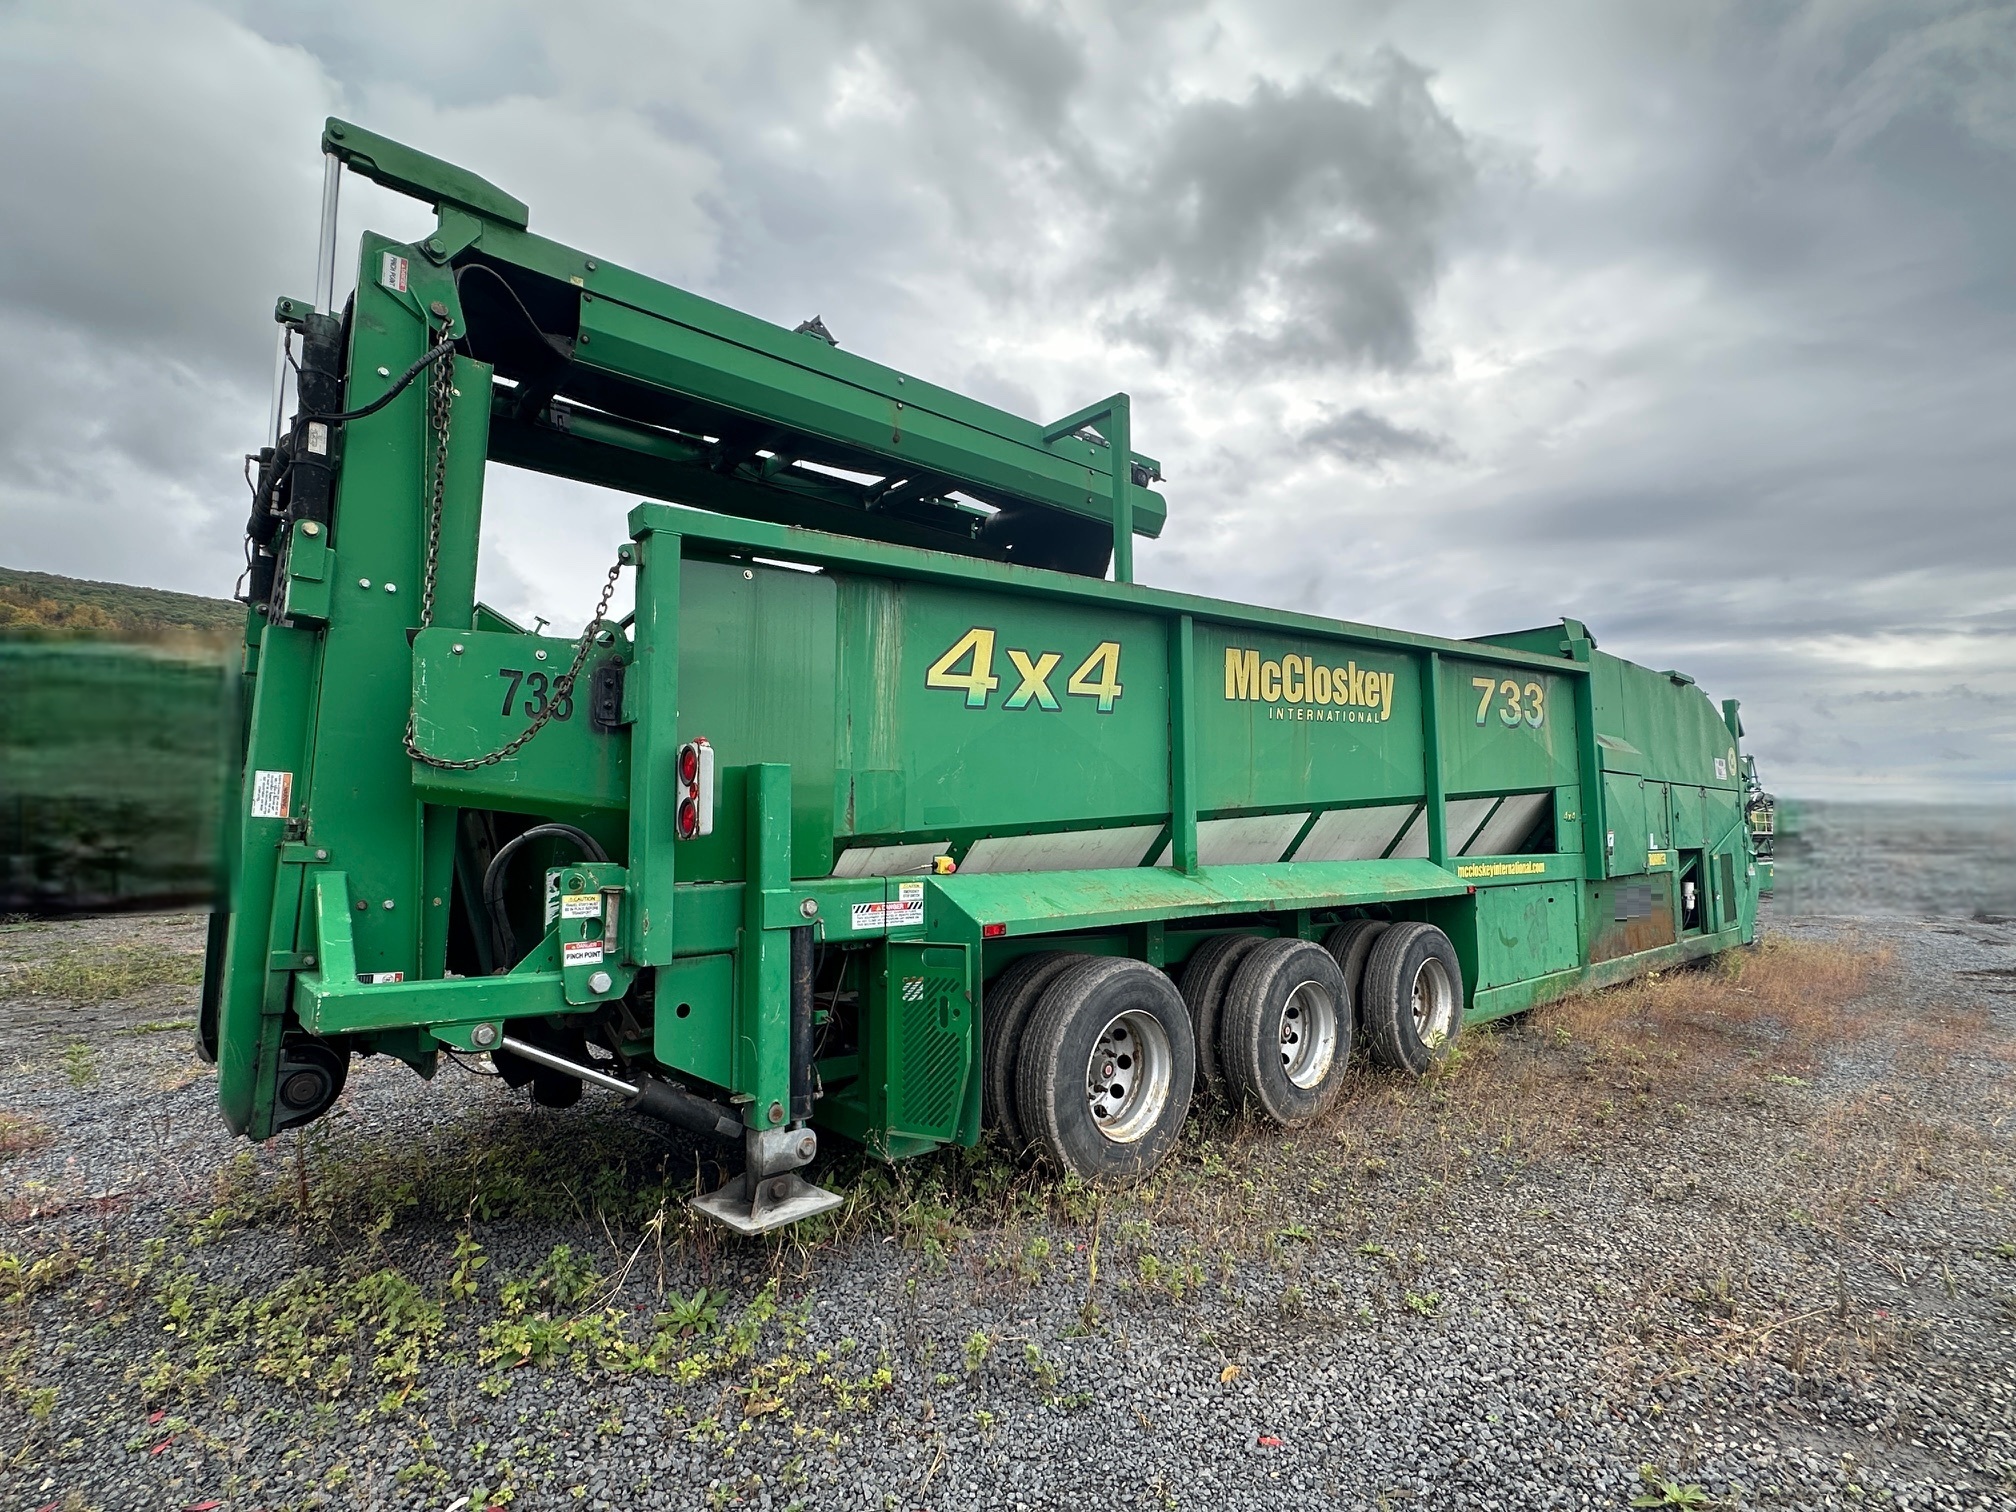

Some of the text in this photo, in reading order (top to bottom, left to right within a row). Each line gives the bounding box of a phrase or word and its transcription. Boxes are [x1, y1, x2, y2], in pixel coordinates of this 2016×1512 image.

[1225, 647, 1394, 721] McCloskey
[1472, 677, 1544, 728] 733
[1269, 706, 1380, 724] INTERNATIONAL
[1457, 861, 1545, 878] mccloskeyinternational.com
[566, 950, 601, 960] PINCH POINT
